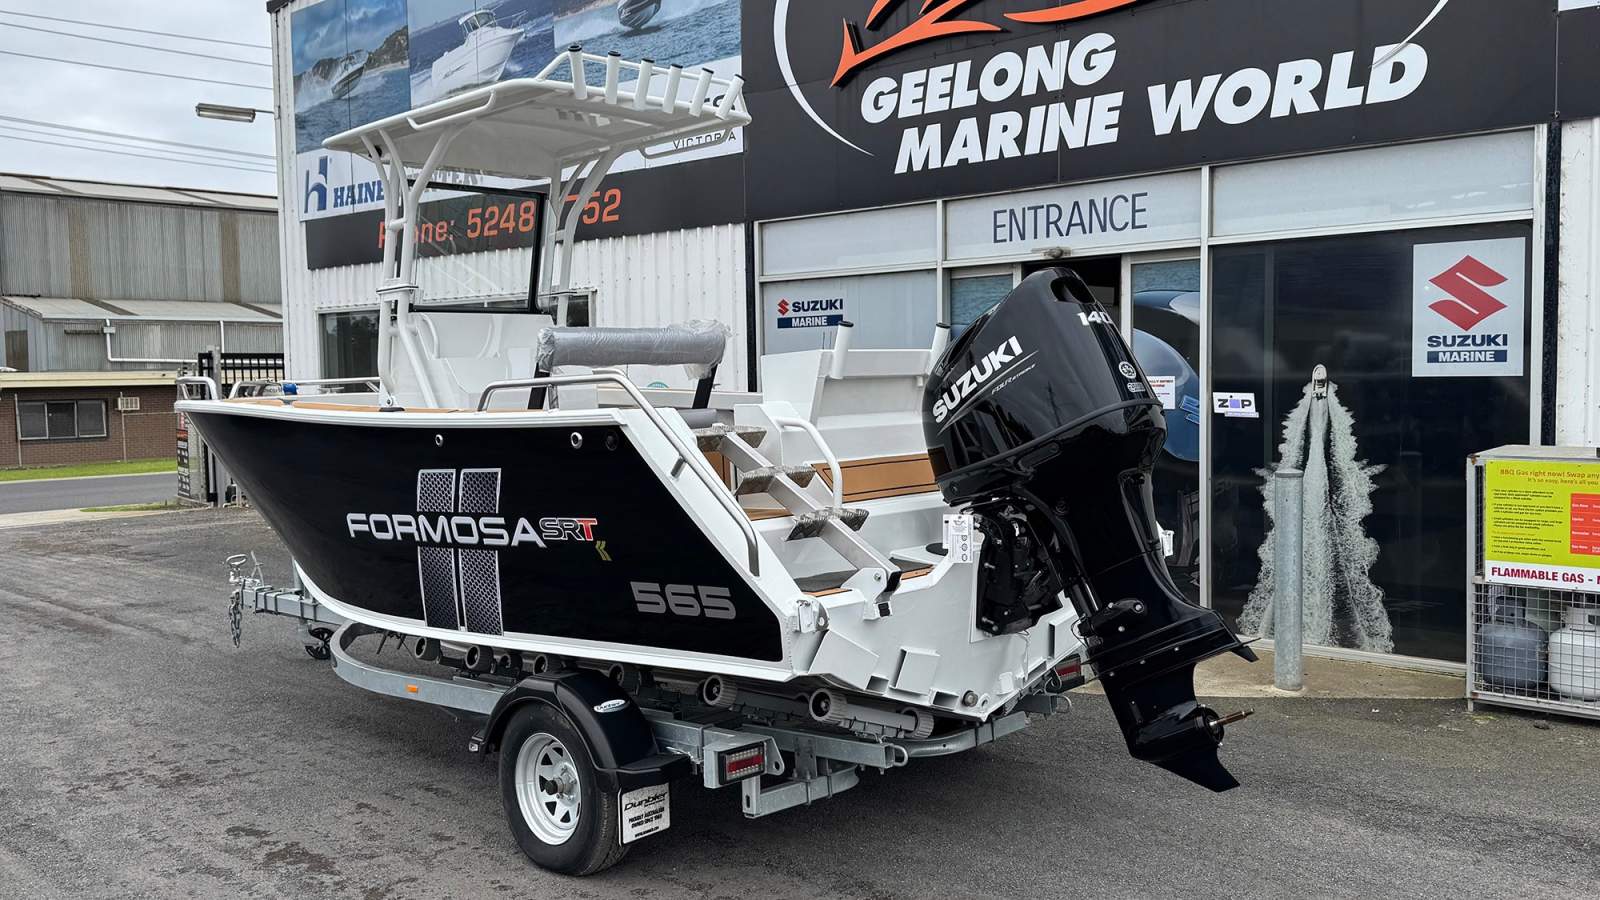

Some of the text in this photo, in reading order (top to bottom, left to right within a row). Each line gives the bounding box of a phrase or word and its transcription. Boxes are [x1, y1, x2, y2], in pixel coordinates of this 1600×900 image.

[860, 32, 1117, 124] GEELONG
[894, 42, 1429, 174] MARINE WORLD
[466, 199, 536, 240] 5248
[993, 192, 1148, 244] ENTRANCE
[791, 298, 844, 313] SUZUKI
[791, 316, 828, 327] MARINE
[1427, 333, 1508, 348] SUZUKI
[1438, 351, 1495, 362] MARINE
[932, 335, 1023, 424] SUZUKI
[346, 512, 598, 549] FORMOSA SRT
[1491, 566, 1559, 581] FLAMMABLE
[1562, 572, 1585, 583] GAS
[629, 581, 737, 620] 565
